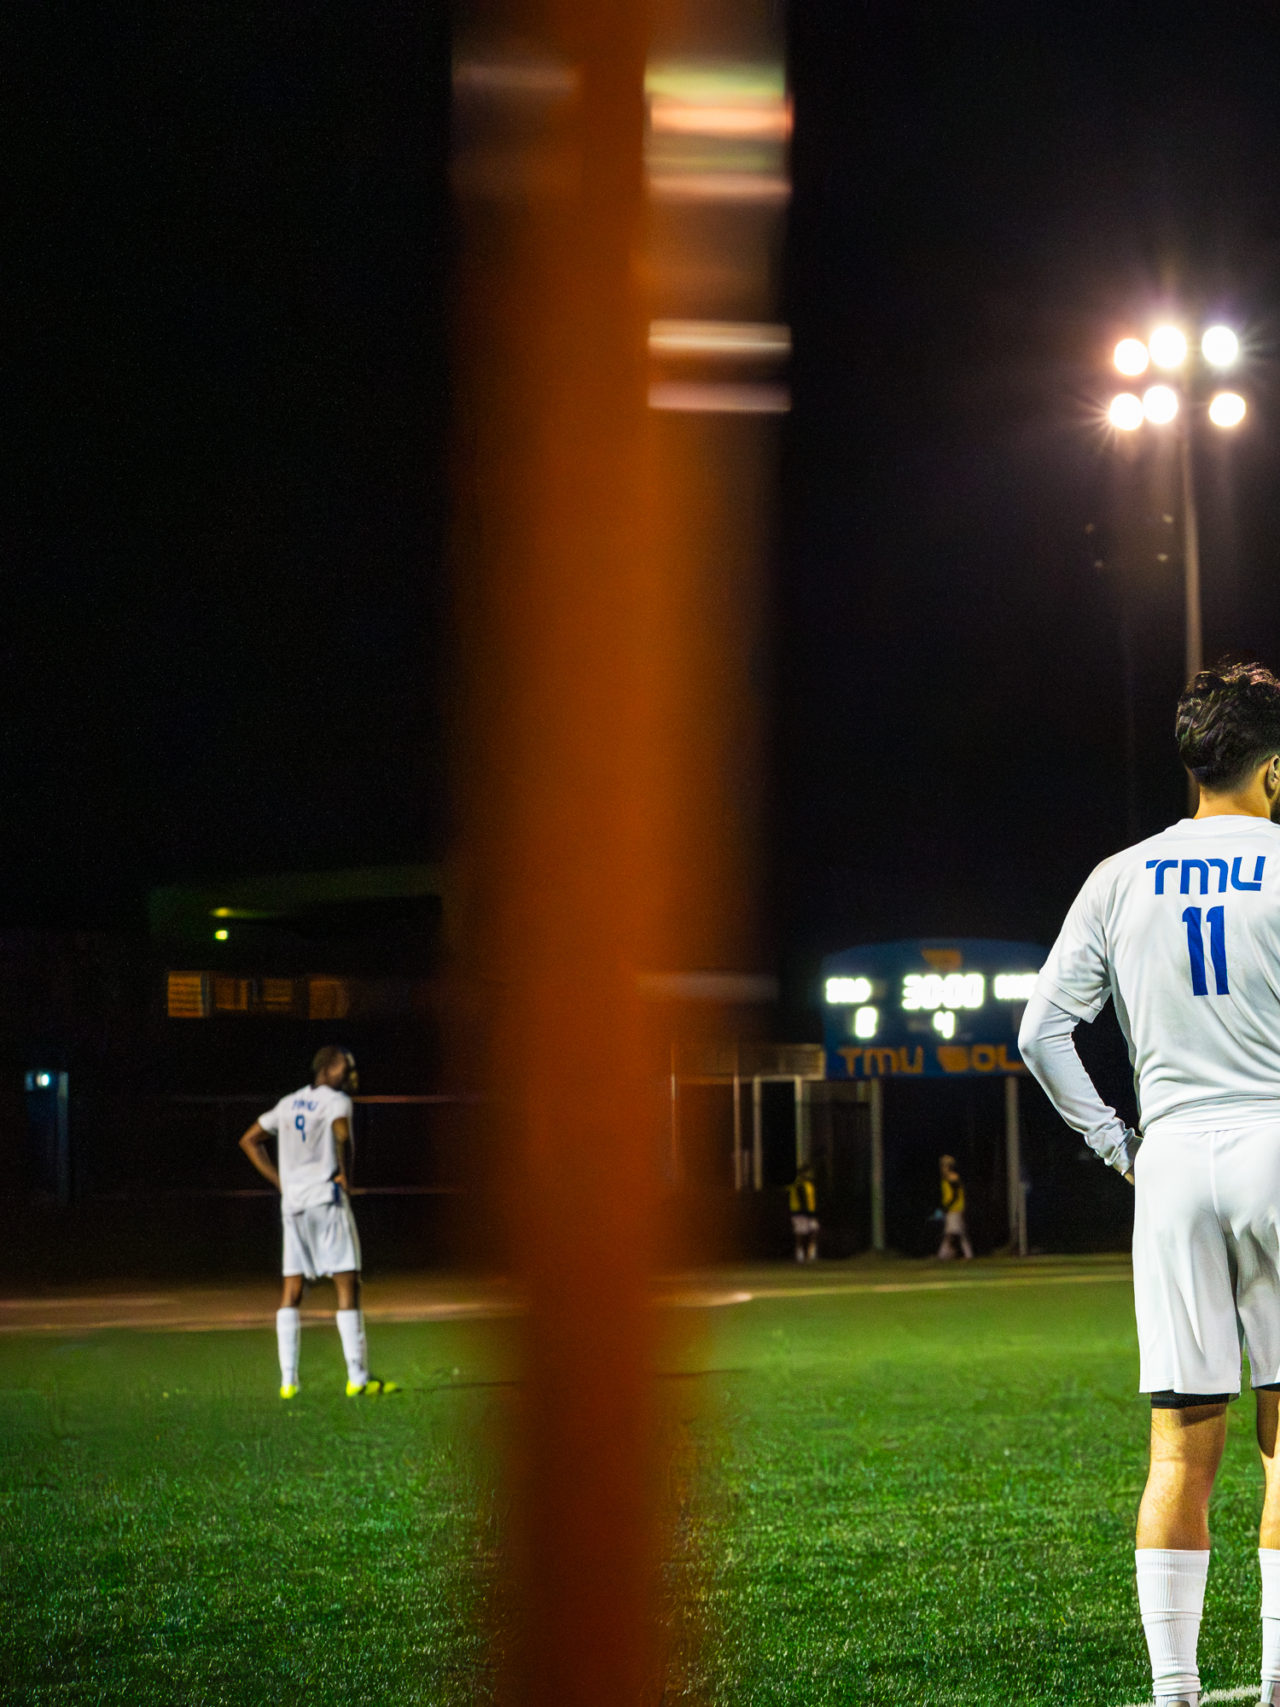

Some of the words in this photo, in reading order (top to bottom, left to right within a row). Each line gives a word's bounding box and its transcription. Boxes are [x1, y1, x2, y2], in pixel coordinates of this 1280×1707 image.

[1146, 856, 1266, 895] TMU
[1182, 905, 1230, 996] 11
[837, 1046, 924, 1076] TMU
[295, 1114, 306, 1143] 9
